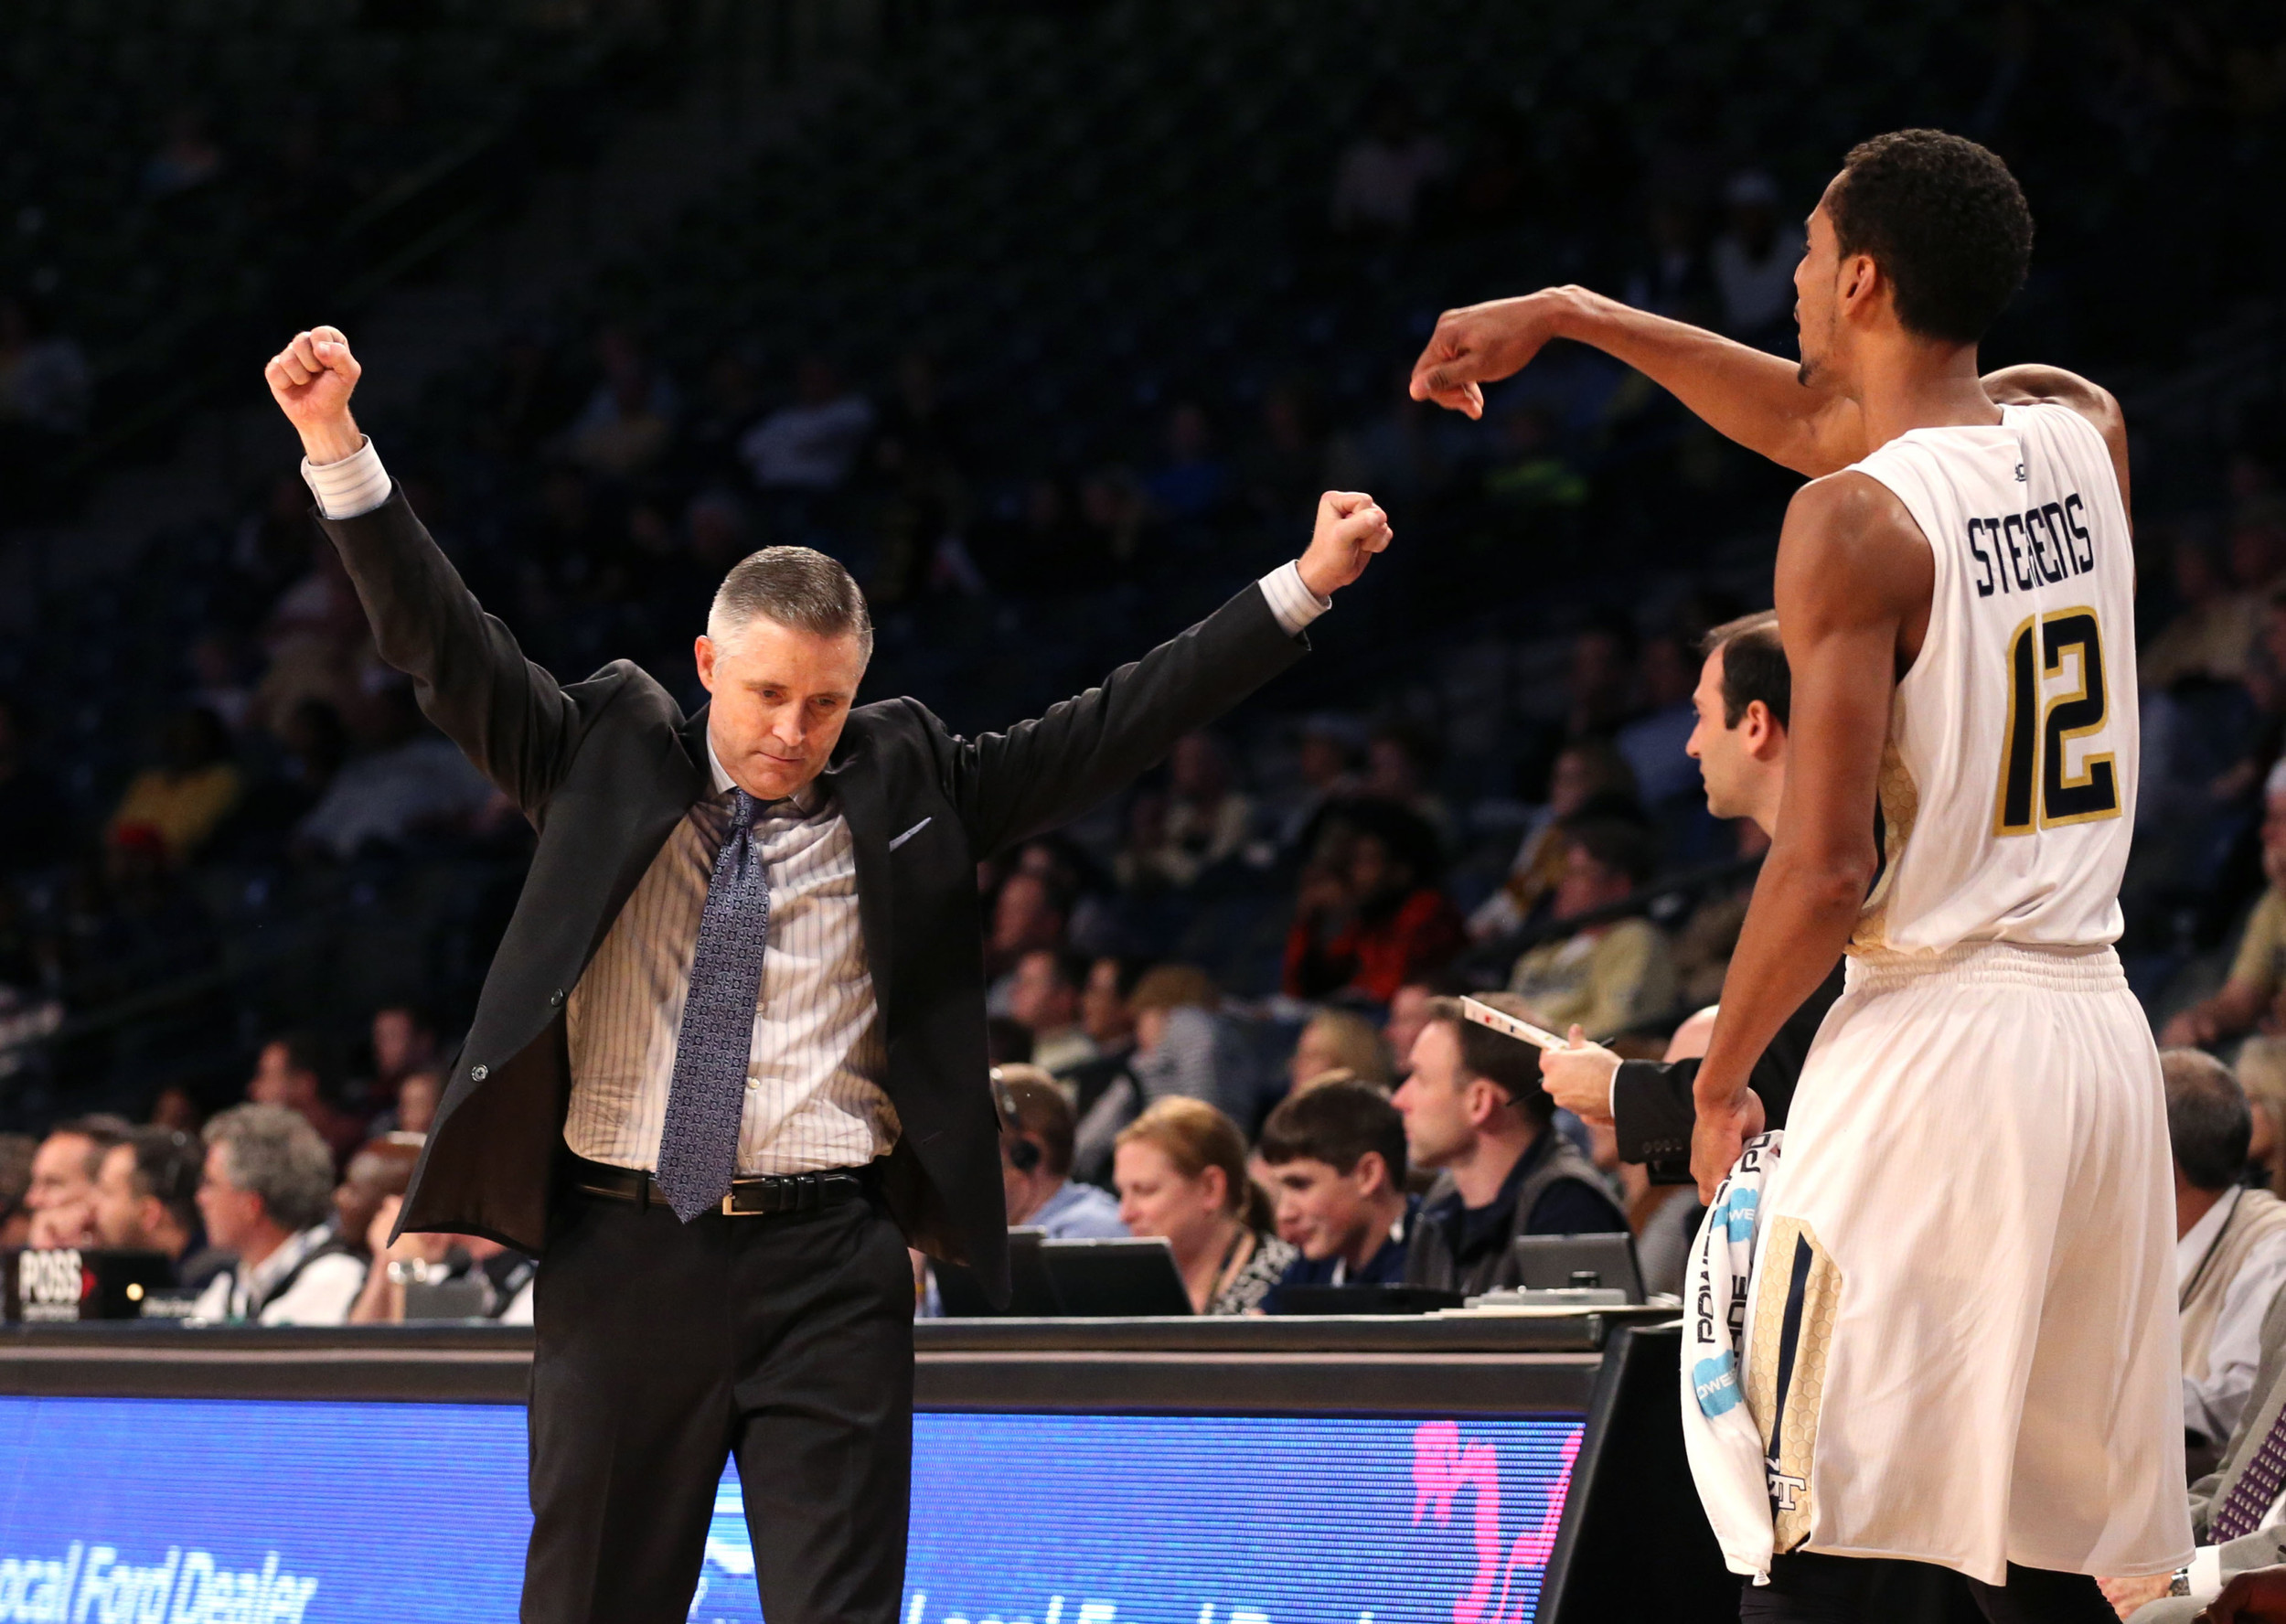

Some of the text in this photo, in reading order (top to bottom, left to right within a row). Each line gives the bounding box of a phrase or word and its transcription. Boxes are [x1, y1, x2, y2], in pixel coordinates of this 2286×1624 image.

[1968, 493, 2094, 597] STEENS
[1993, 605, 2122, 837] 12
[0, 1540, 318, 1624] ocal Ford Dealer
